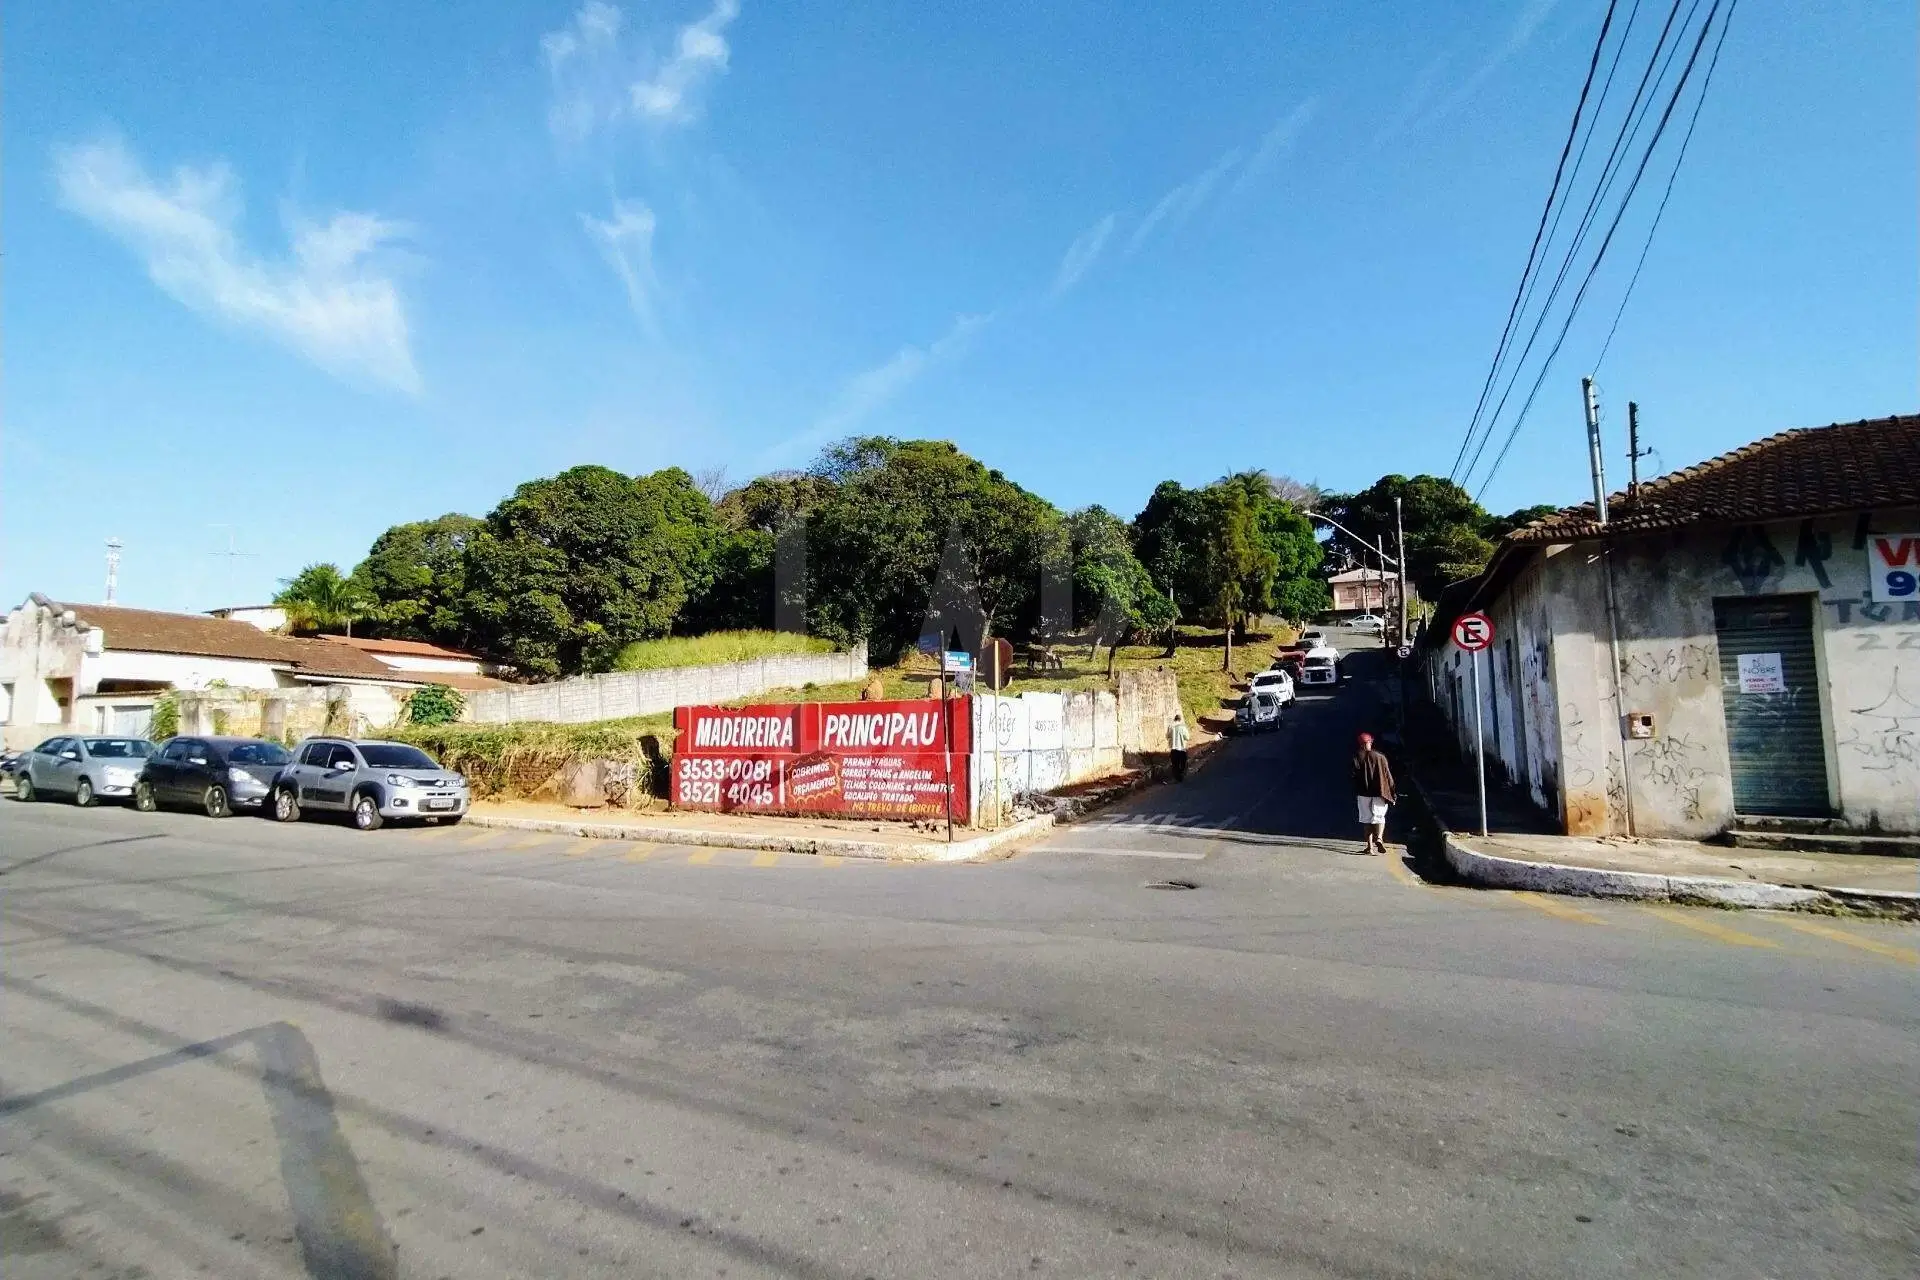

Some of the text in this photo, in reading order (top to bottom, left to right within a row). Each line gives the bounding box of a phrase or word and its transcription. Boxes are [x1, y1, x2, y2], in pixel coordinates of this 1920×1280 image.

[1875, 538, 1920, 566] V
[1886, 571, 1920, 596] 9
[695, 712, 939, 747] MADEIREIRA PRINCIPAU
[792, 762, 830, 779] COBRIMOS
[844, 780, 866, 790] TELHAS
[852, 802, 864, 811] NO
[868, 802, 892, 811] TREVO
